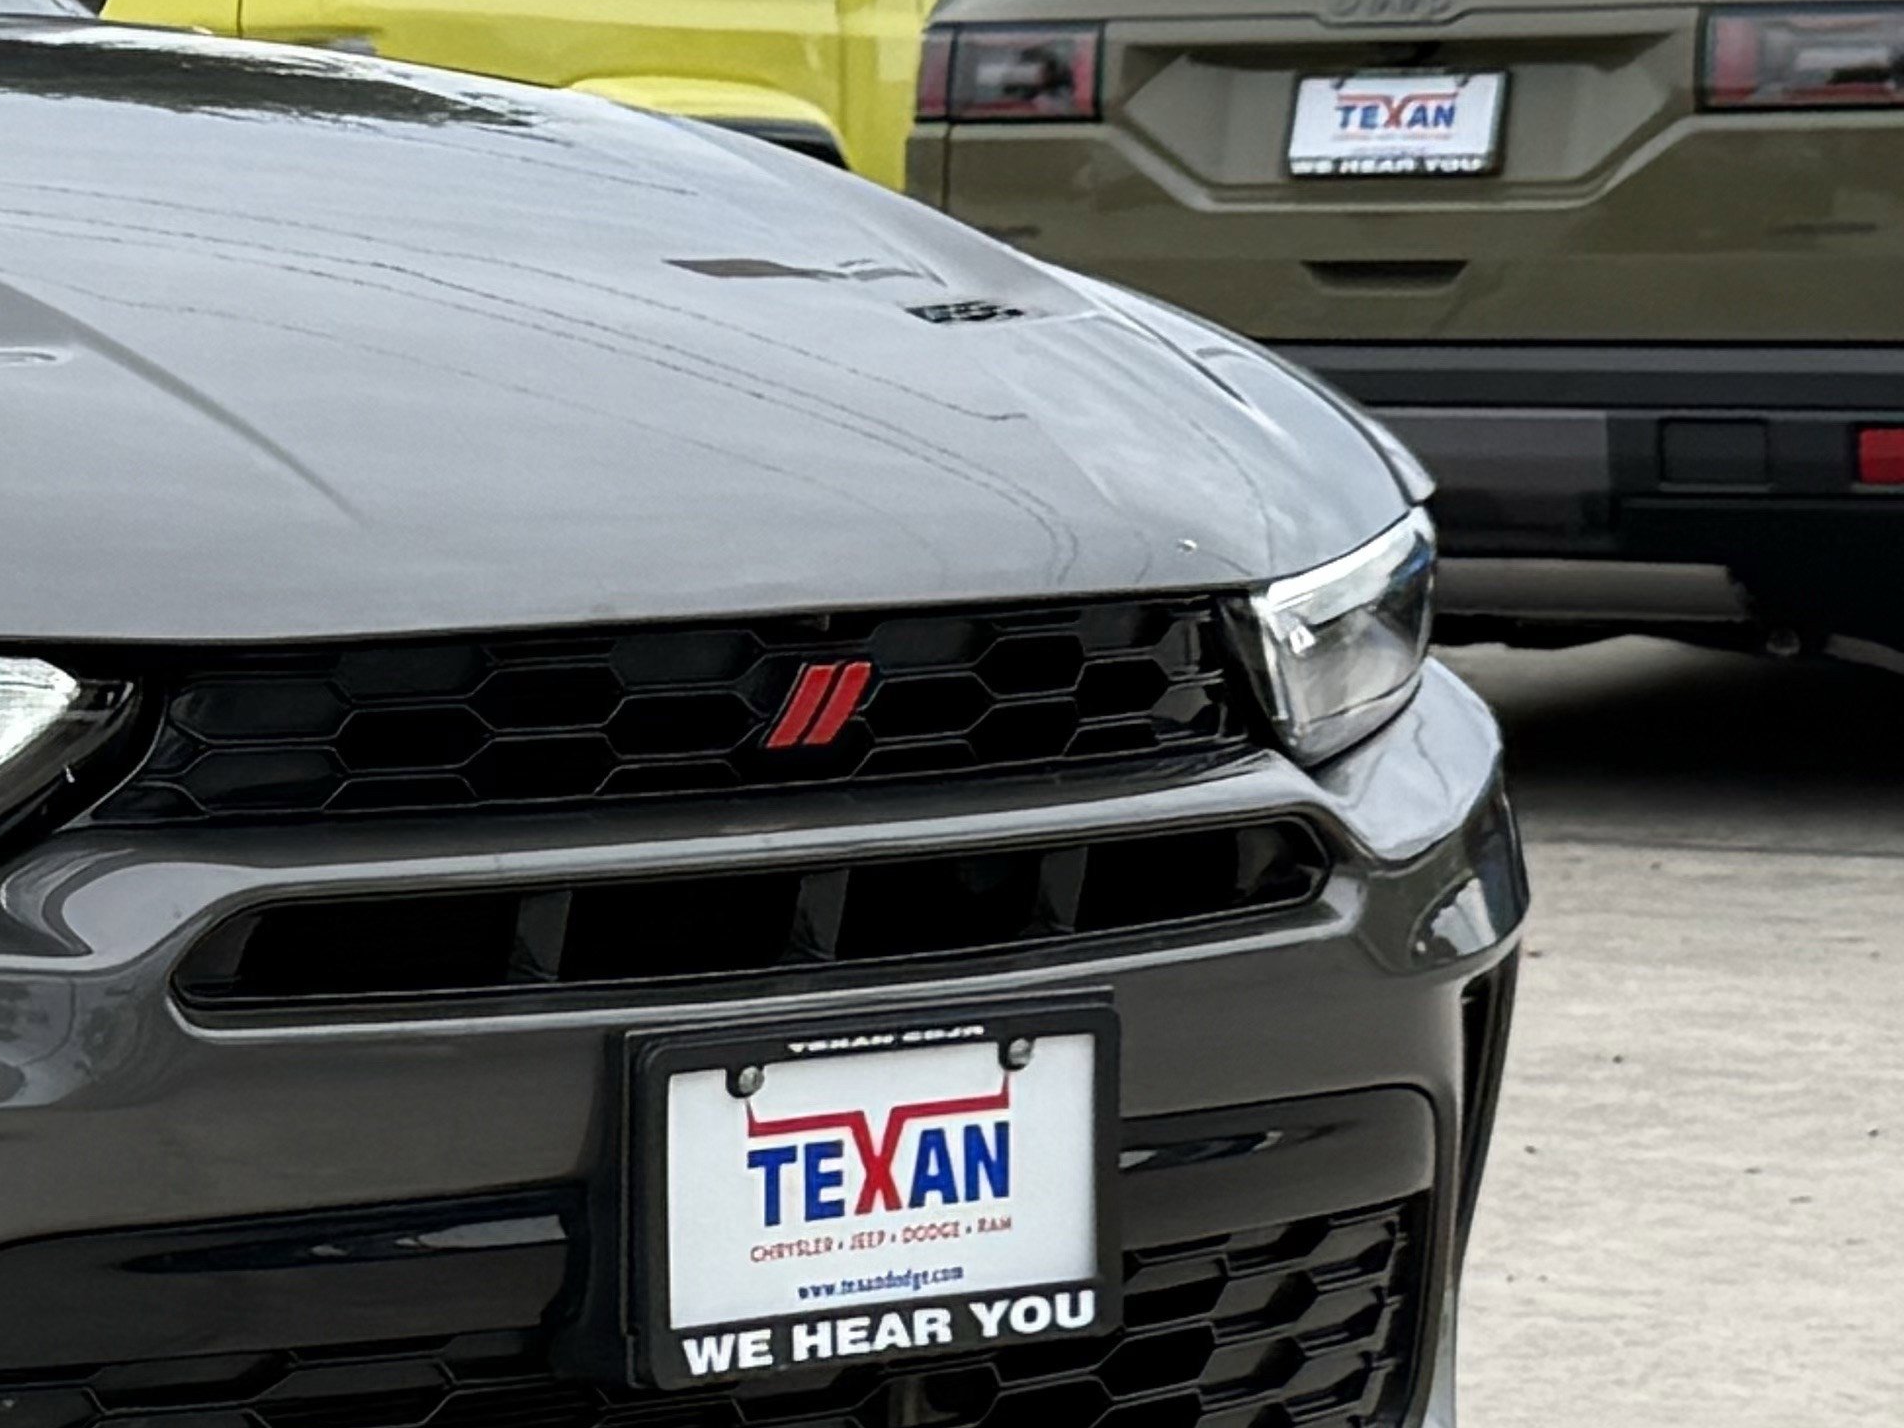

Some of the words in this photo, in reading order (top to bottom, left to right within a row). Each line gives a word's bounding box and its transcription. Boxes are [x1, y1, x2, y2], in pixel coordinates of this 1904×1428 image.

[1334, 92, 1457, 129] TEXAN
[747, 1100, 1010, 1227] TEXAN
[750, 1236, 834, 1263] CHRYSLER
[849, 1229, 886, 1251] JEEP
[901, 1221, 961, 1244] DODGE
[977, 1215, 1013, 1234] RAM
[797, 1265, 965, 1300] www.texandodge.com
[682, 1329, 773, 1374] WE
[792, 1307, 953, 1362] HEAR
[968, 1289, 1095, 1339] YOU
